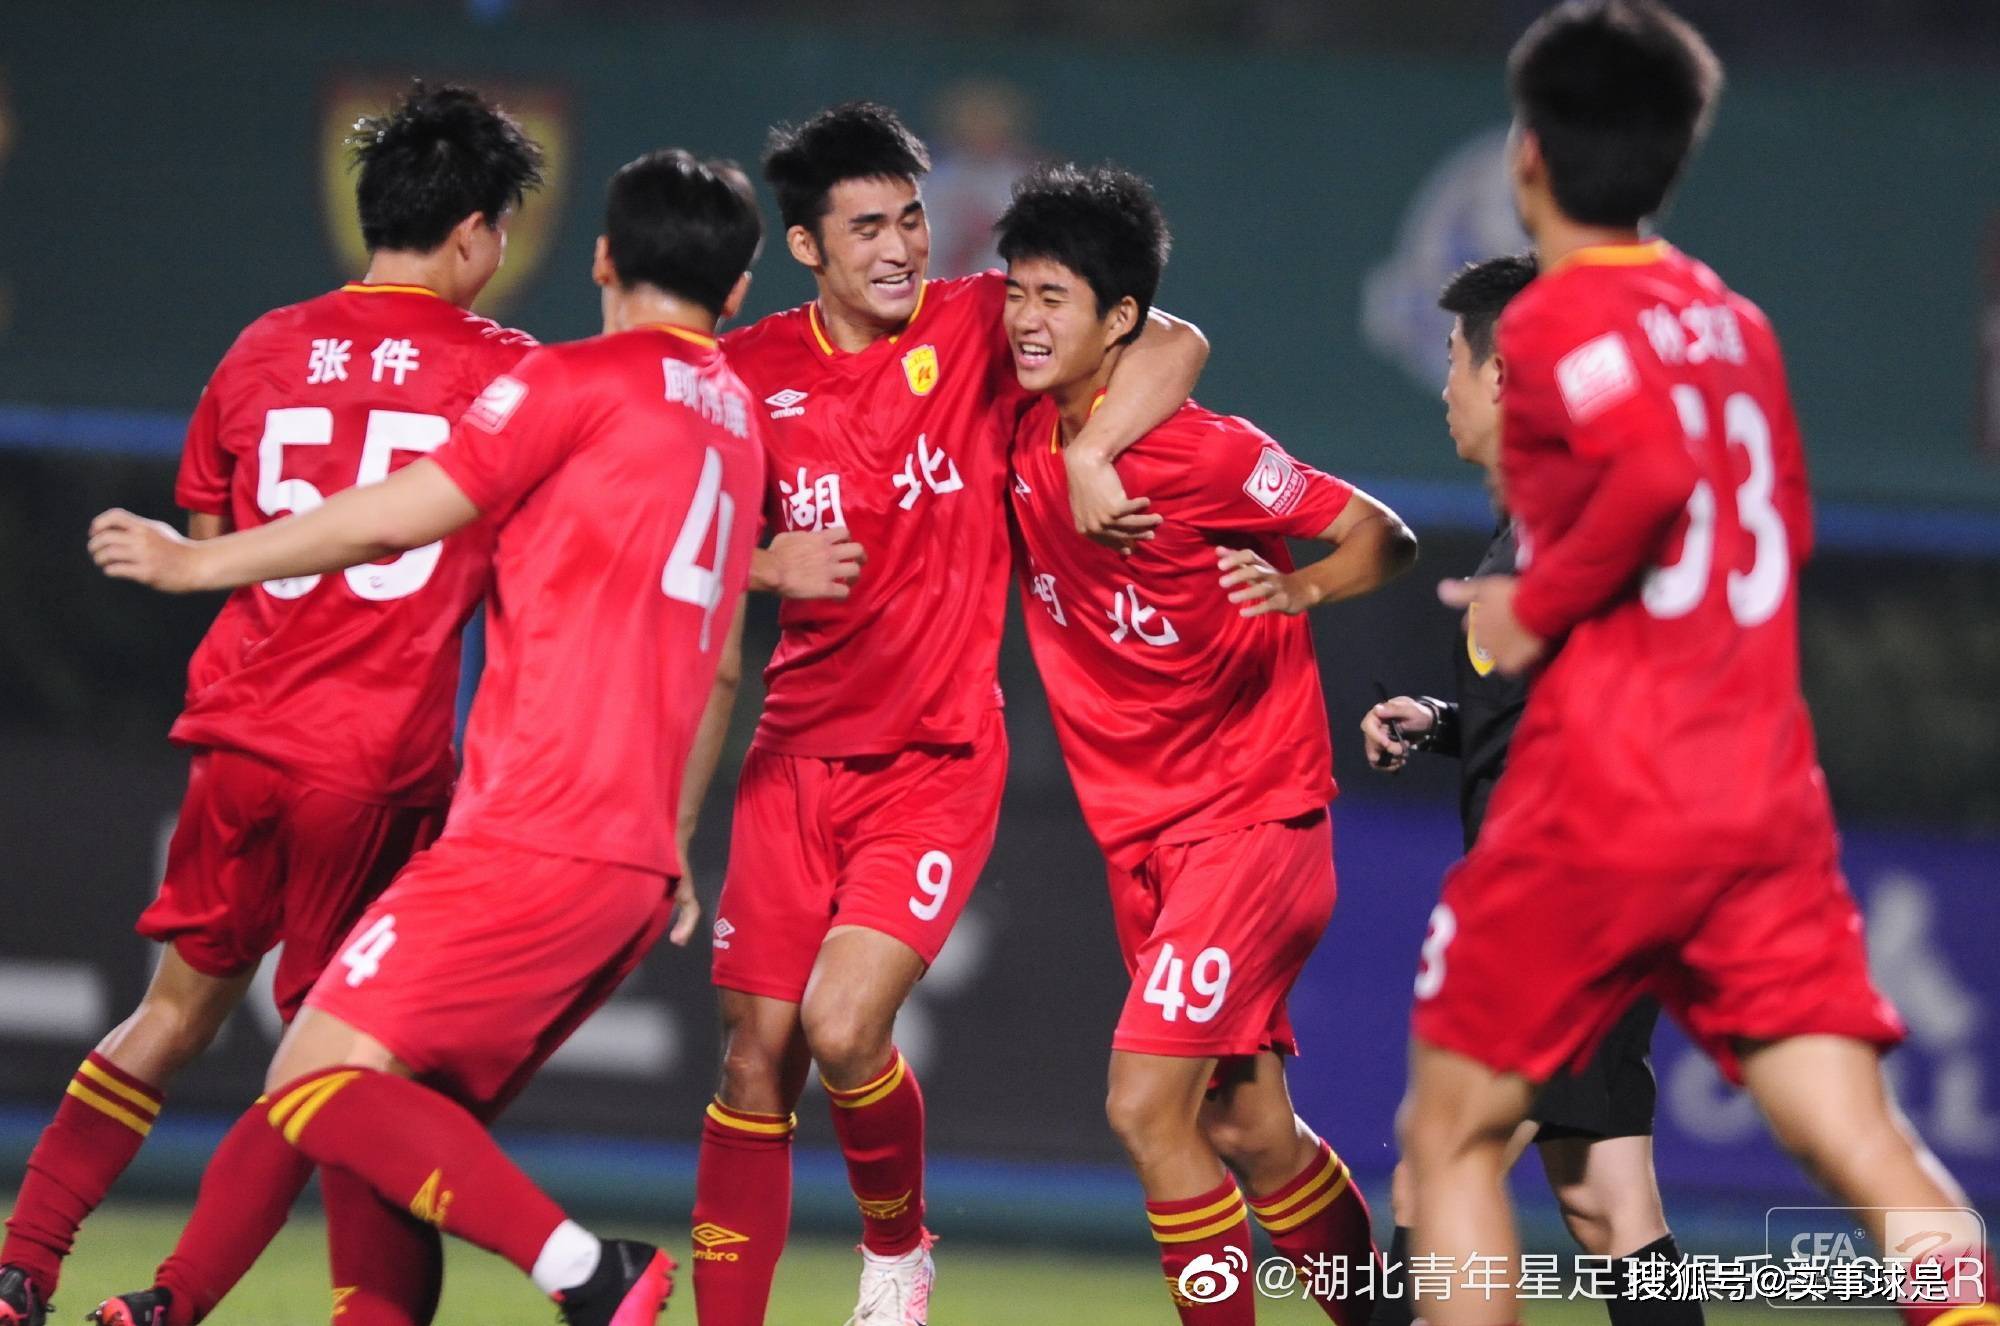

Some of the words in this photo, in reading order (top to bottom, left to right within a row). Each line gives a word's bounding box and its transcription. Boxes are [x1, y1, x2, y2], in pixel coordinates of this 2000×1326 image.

[306, 337, 420, 386] 张件
[257, 407, 450, 602] 55
[778, 432, 965, 533] 湖北
[661, 446, 735, 652] 4
[907, 849, 953, 921] 9
[339, 914, 397, 988] 4
[1142, 942, 1232, 1024] 49
